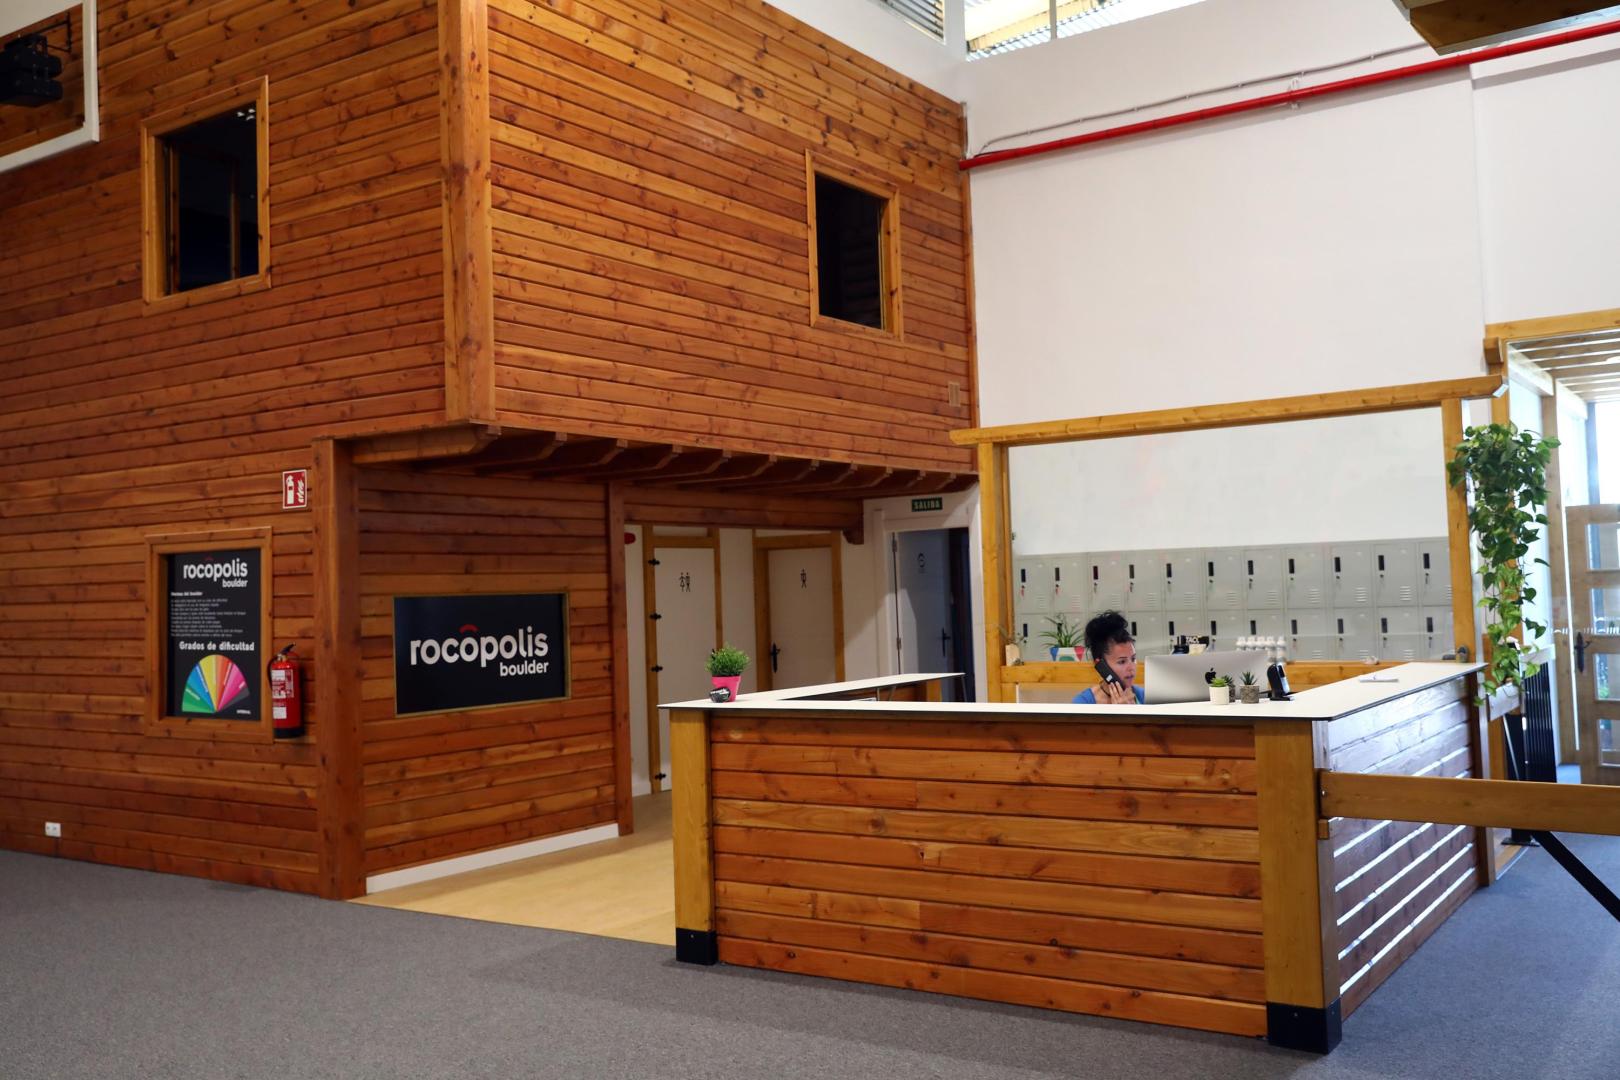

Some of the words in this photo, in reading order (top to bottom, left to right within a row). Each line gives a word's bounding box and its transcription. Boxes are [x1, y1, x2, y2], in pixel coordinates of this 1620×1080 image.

[914, 499, 940, 509] SALIDA
[183, 558, 248, 582] rocopolis
[222, 578, 248, 588] boulder
[179, 641, 205, 651] Grados
[207, 641, 217, 651] de
[219, 641, 255, 651] dificultad
[499, 660, 550, 677] boulder
